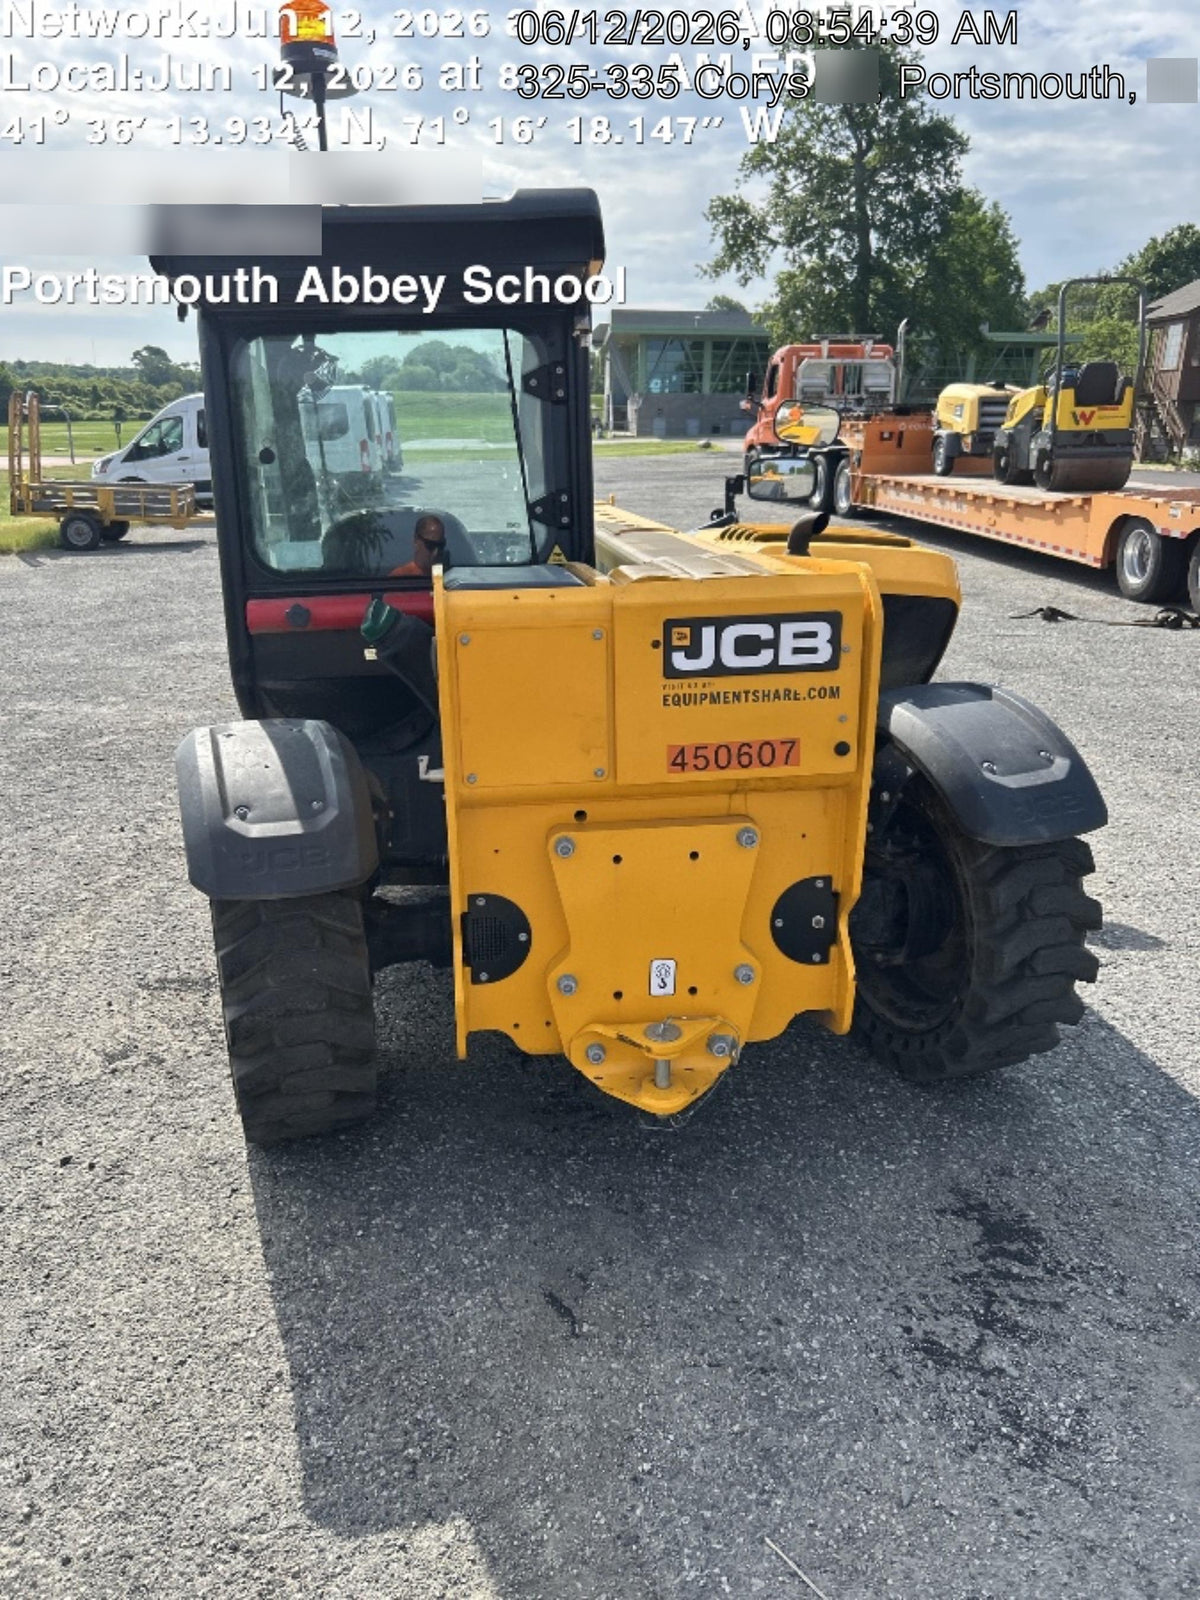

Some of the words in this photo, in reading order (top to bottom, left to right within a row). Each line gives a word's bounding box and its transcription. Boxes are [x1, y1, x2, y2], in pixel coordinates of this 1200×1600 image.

[671, 621, 832, 671] JCB
[662, 686, 841, 708] EQUIPMENTSHARE.COM
[669, 740, 797, 773] 450607
